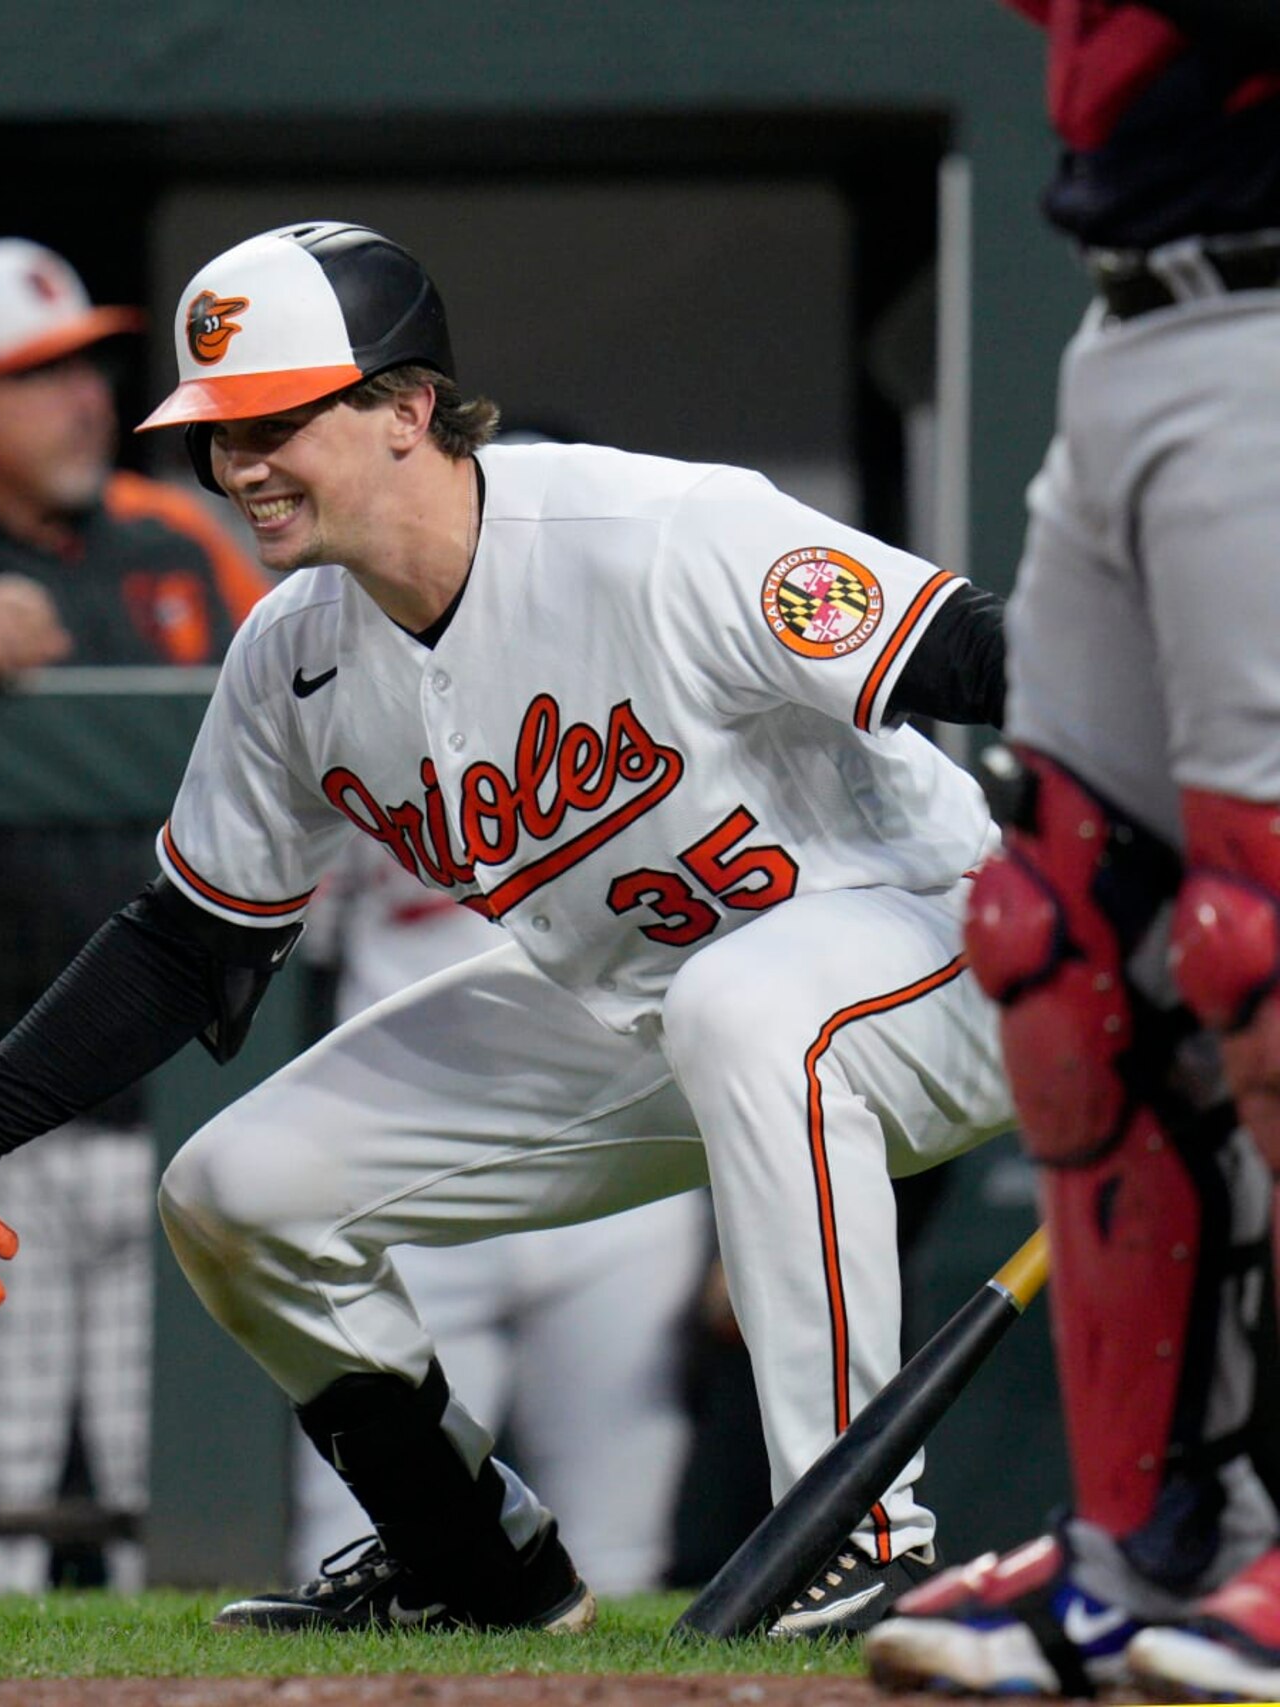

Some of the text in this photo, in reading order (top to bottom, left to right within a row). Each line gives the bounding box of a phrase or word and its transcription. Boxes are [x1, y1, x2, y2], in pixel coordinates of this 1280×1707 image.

[763, 549, 828, 633] BALTIMORE
[833, 584, 880, 654] ORIOLES
[321, 693, 685, 922] Orioles
[606, 804, 800, 948] 35
